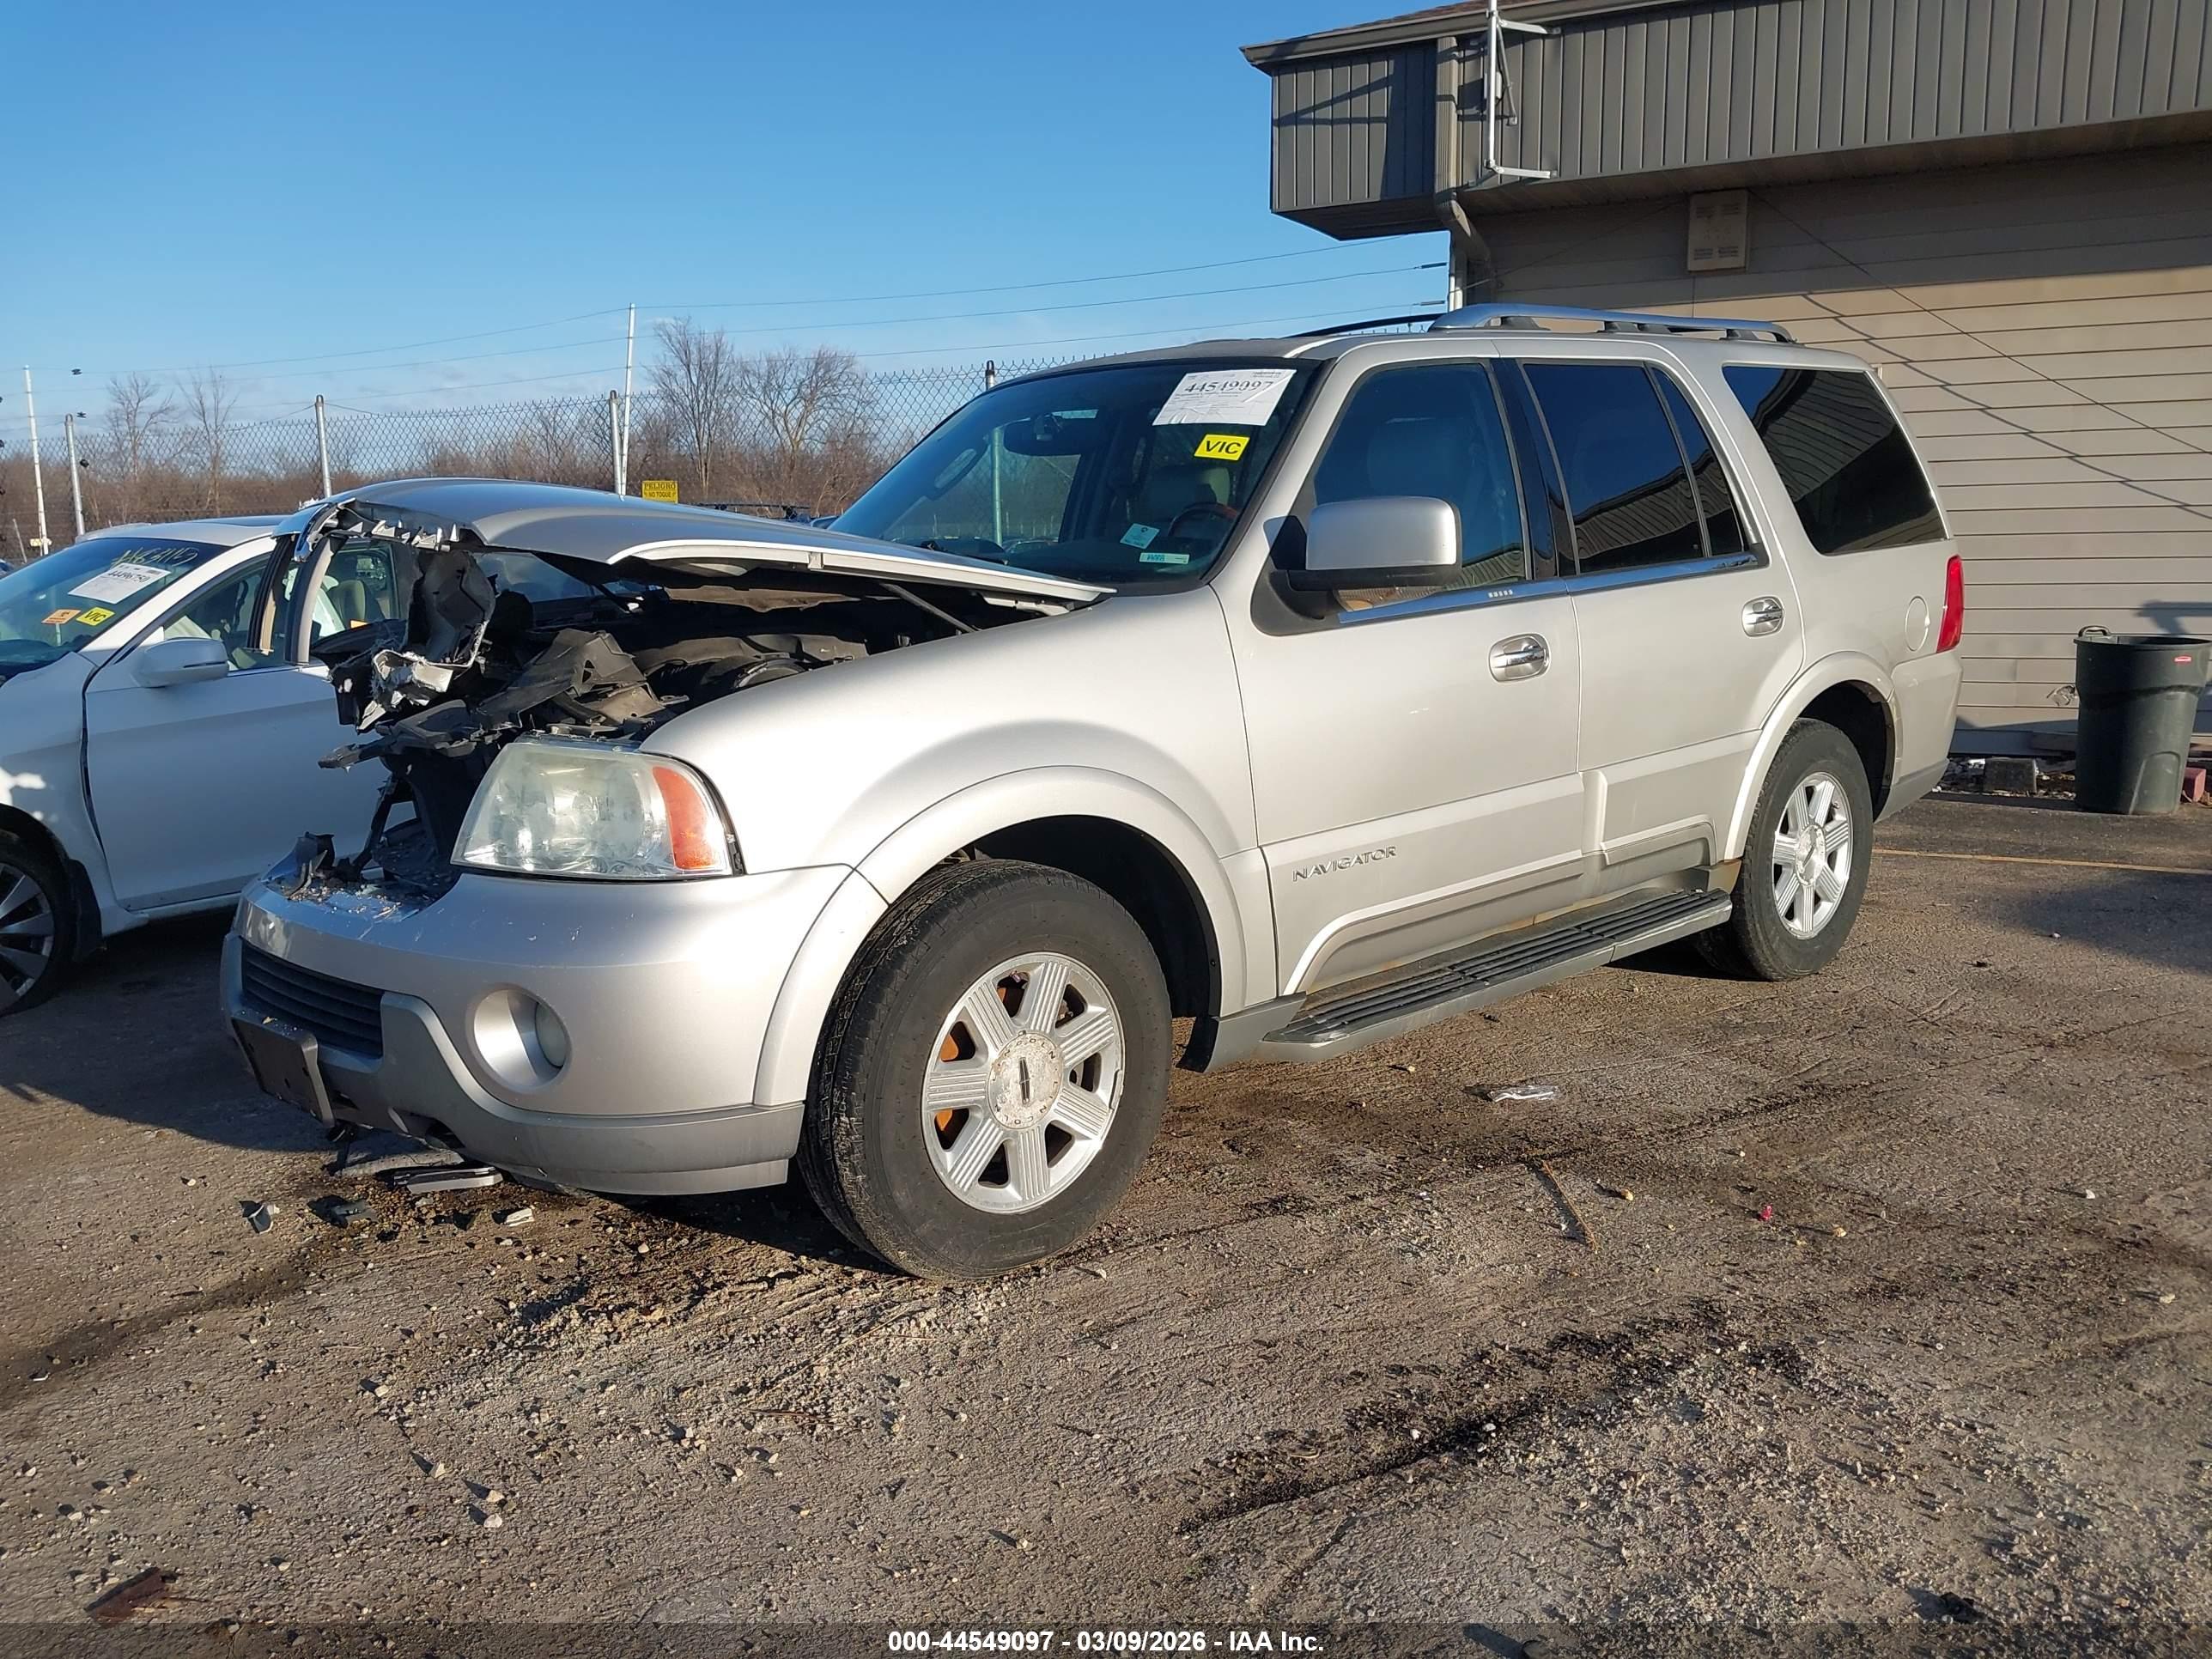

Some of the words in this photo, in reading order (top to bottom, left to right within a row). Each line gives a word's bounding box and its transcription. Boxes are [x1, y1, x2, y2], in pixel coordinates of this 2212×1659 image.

[1184, 380, 1274, 393] 44549097
[1204, 439, 1243, 454] VIC
[84, 611, 106, 622] VIC
[1292, 846, 1397, 882] NAVIGATOR
